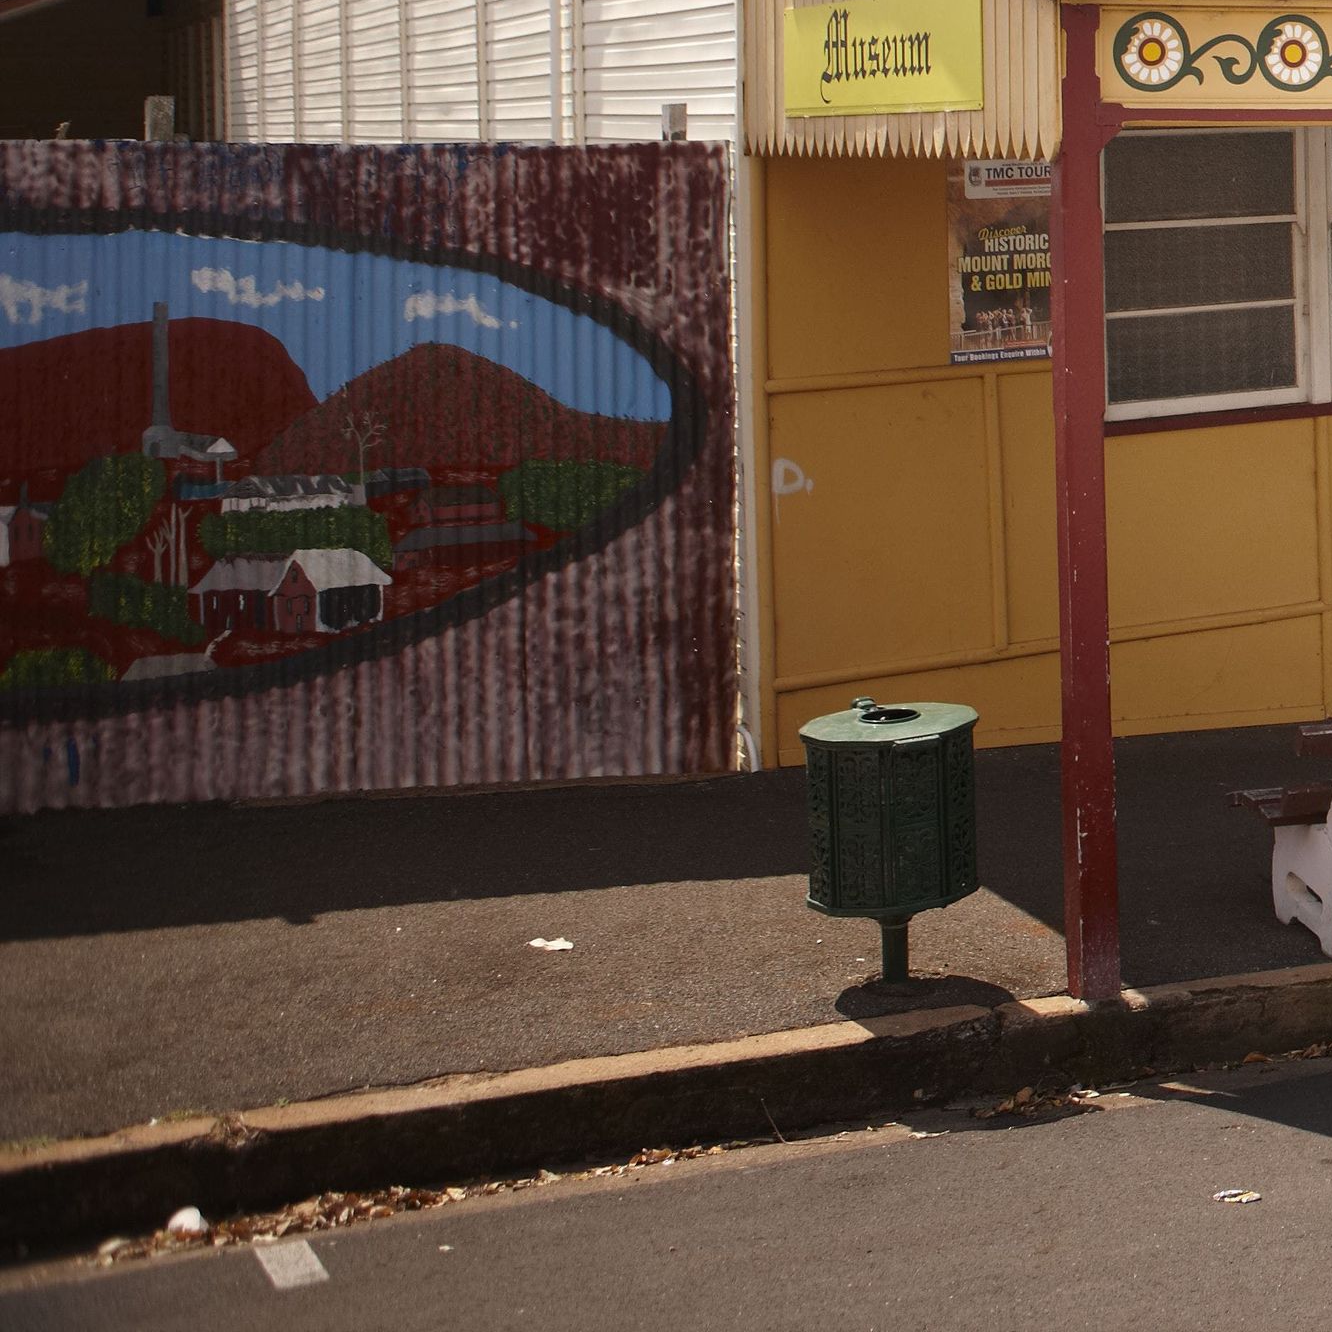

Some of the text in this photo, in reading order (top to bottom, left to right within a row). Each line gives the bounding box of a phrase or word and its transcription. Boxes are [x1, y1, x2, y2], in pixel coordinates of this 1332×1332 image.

[820, 8, 932, 104] Museum
[985, 167, 1014, 180] TMC
[978, 224, 1027, 240] Discover
[984, 234, 1049, 253] HISTORIC
[958, 254, 1009, 273] MOUNT
[971, 275, 982, 291] &
[985, 273, 1023, 291] GOLD
